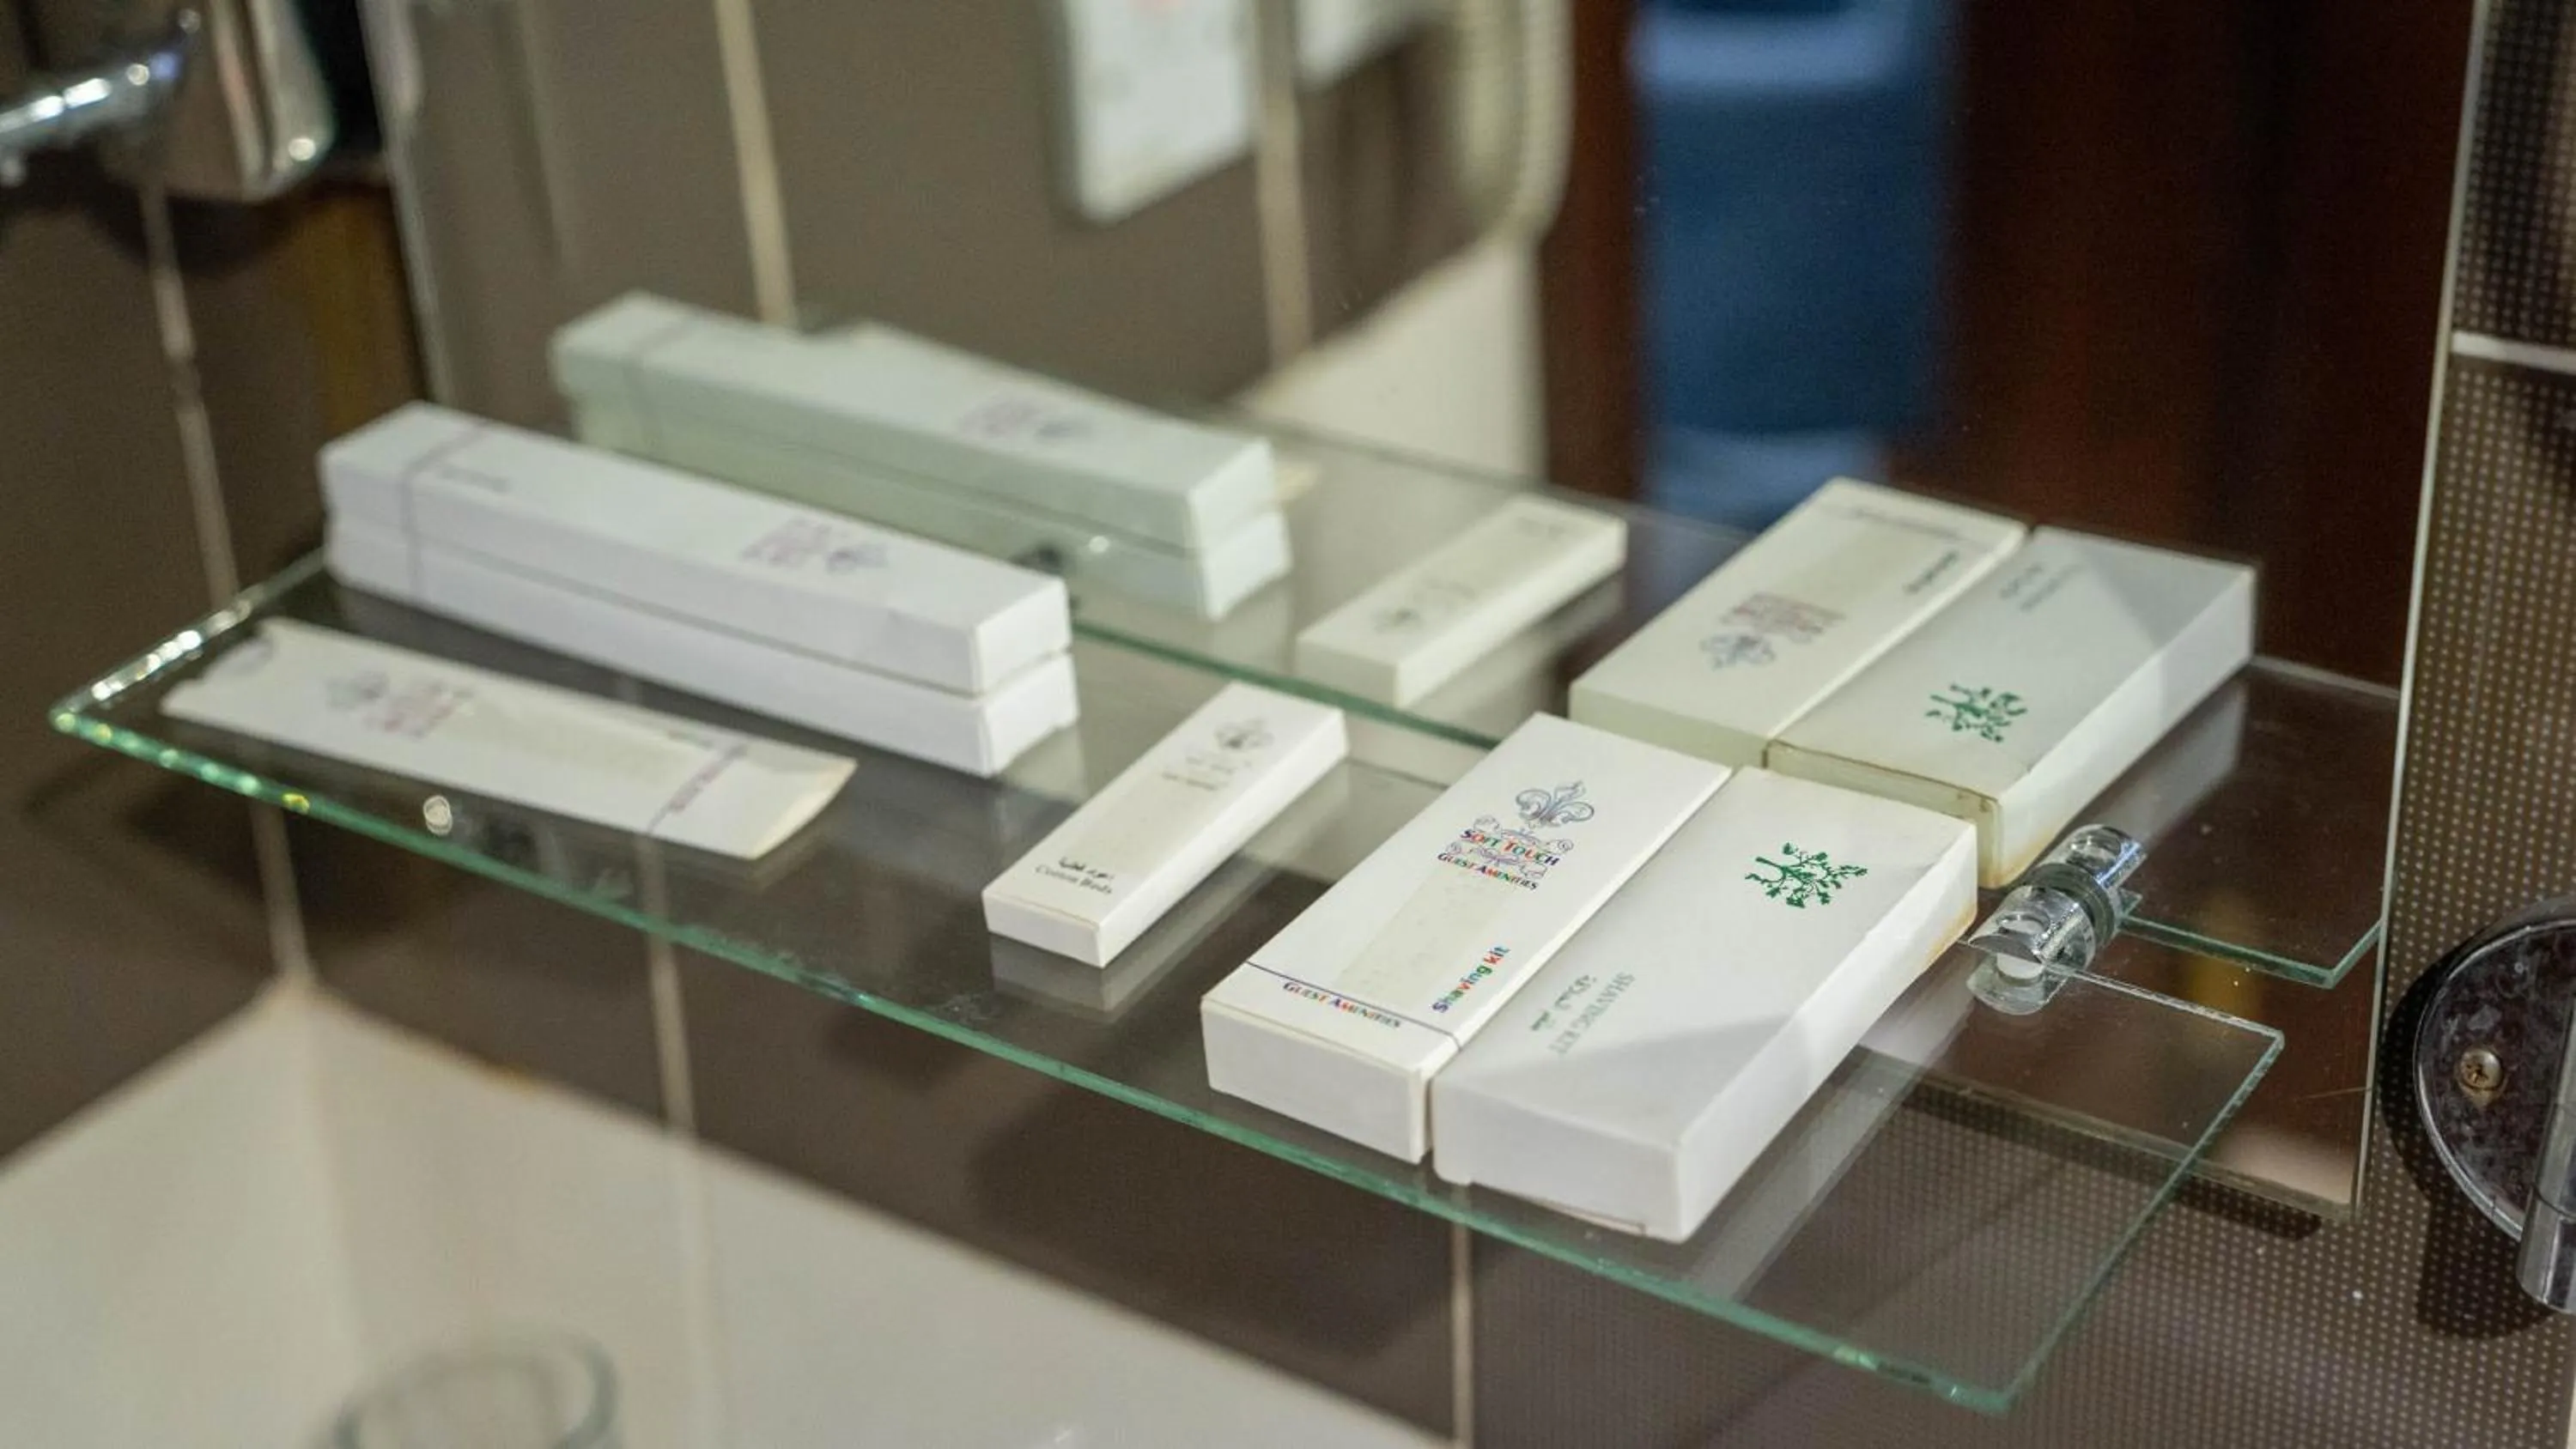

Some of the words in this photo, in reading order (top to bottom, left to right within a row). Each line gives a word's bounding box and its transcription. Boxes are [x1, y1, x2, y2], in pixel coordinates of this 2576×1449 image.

[1460, 829, 1499, 847] SOFT
[1503, 838, 1559, 865] TOUCH
[1437, 852, 1476, 869] GUEST
[1477, 864, 1538, 890] AMENITIES
[1431, 964, 1492, 1013] Shaving
